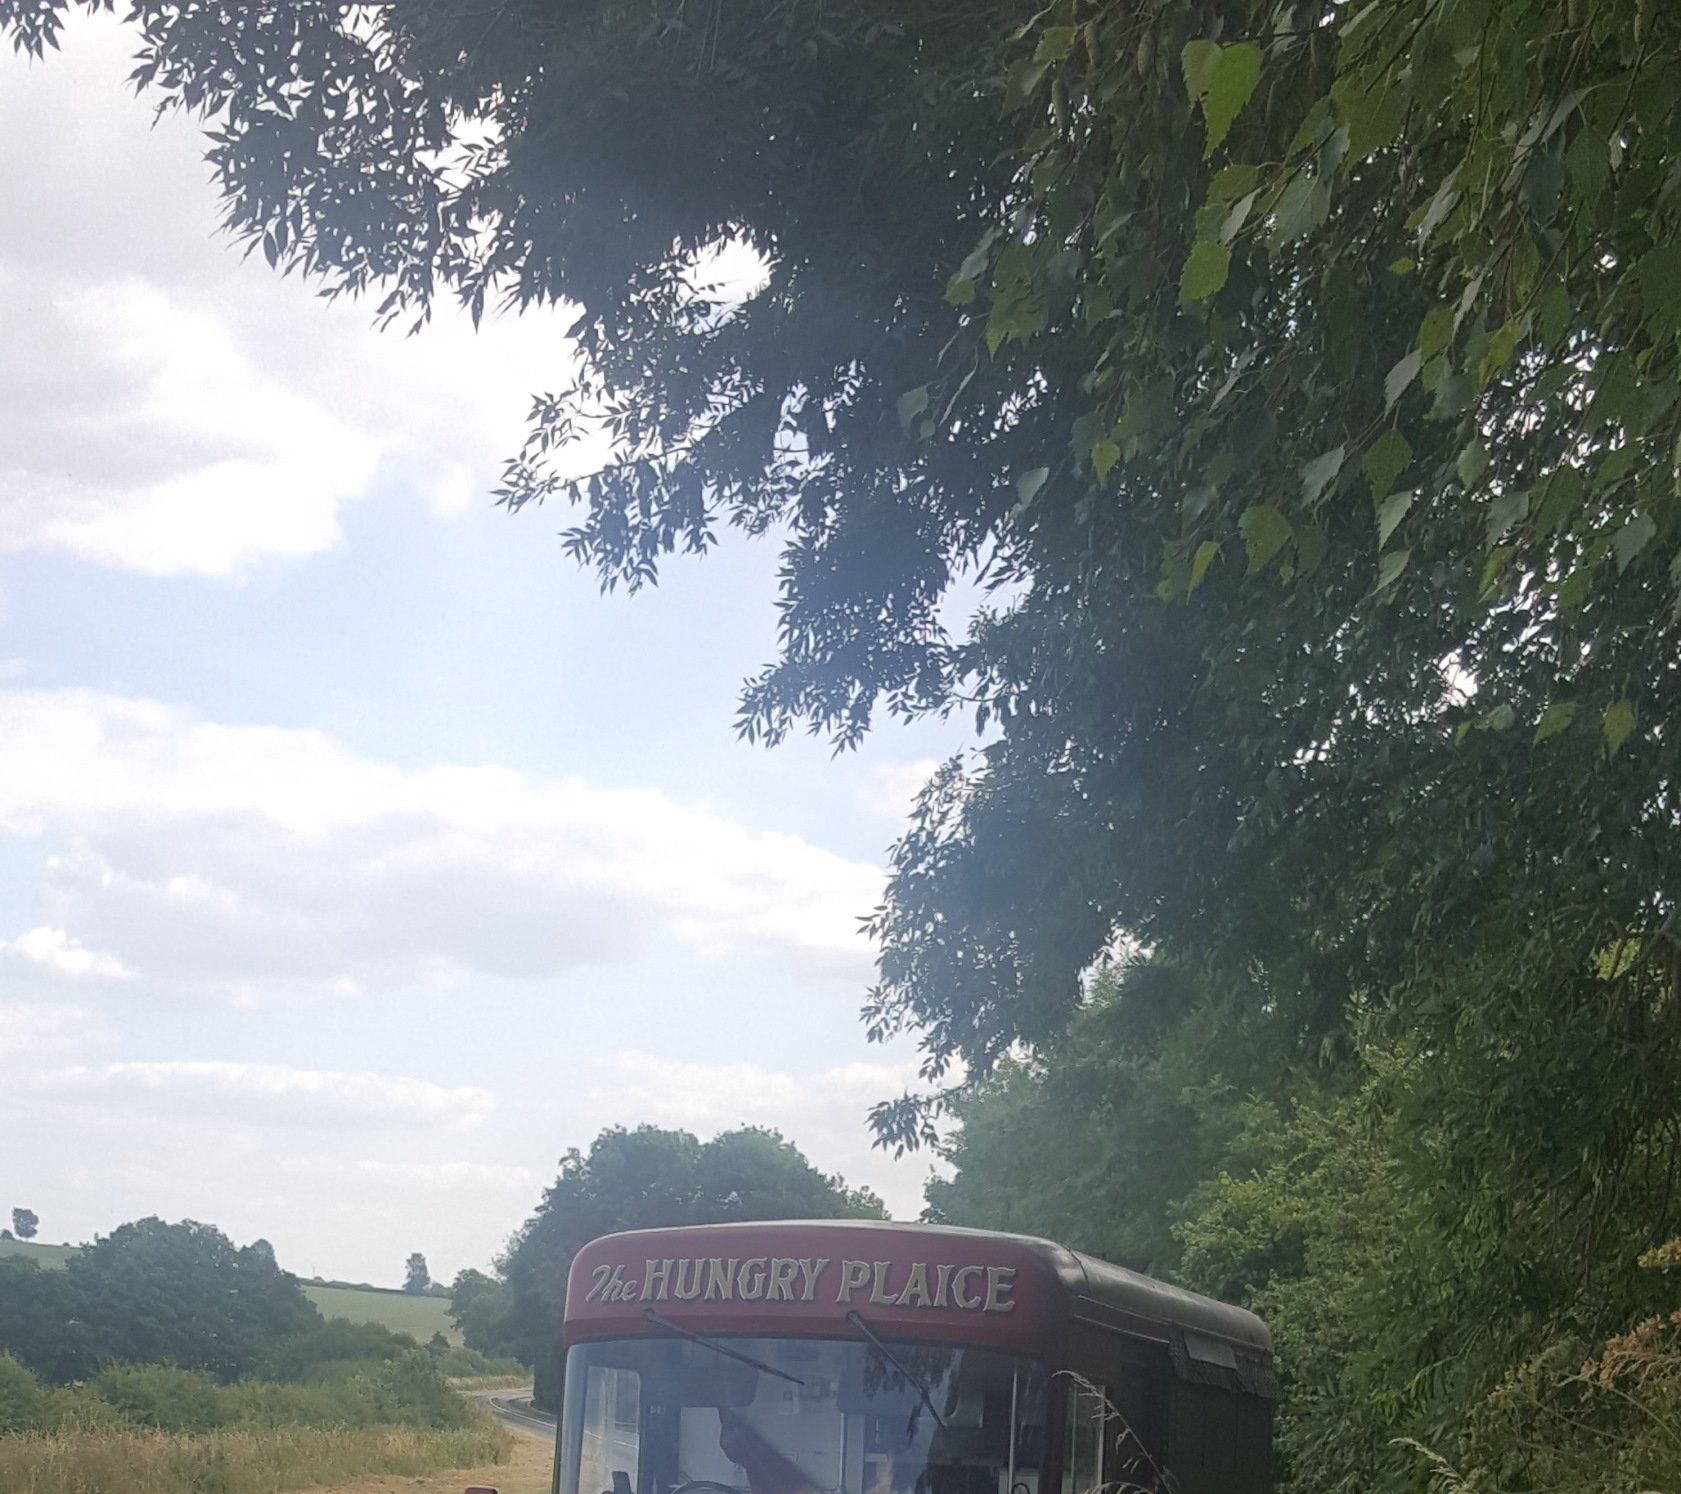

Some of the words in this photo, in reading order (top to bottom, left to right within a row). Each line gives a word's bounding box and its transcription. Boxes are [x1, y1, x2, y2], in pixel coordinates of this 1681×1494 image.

[585, 1265, 638, 1302] The
[640, 1257, 830, 1301] HUNGRY
[836, 1259, 1016, 1313] PLAICE
